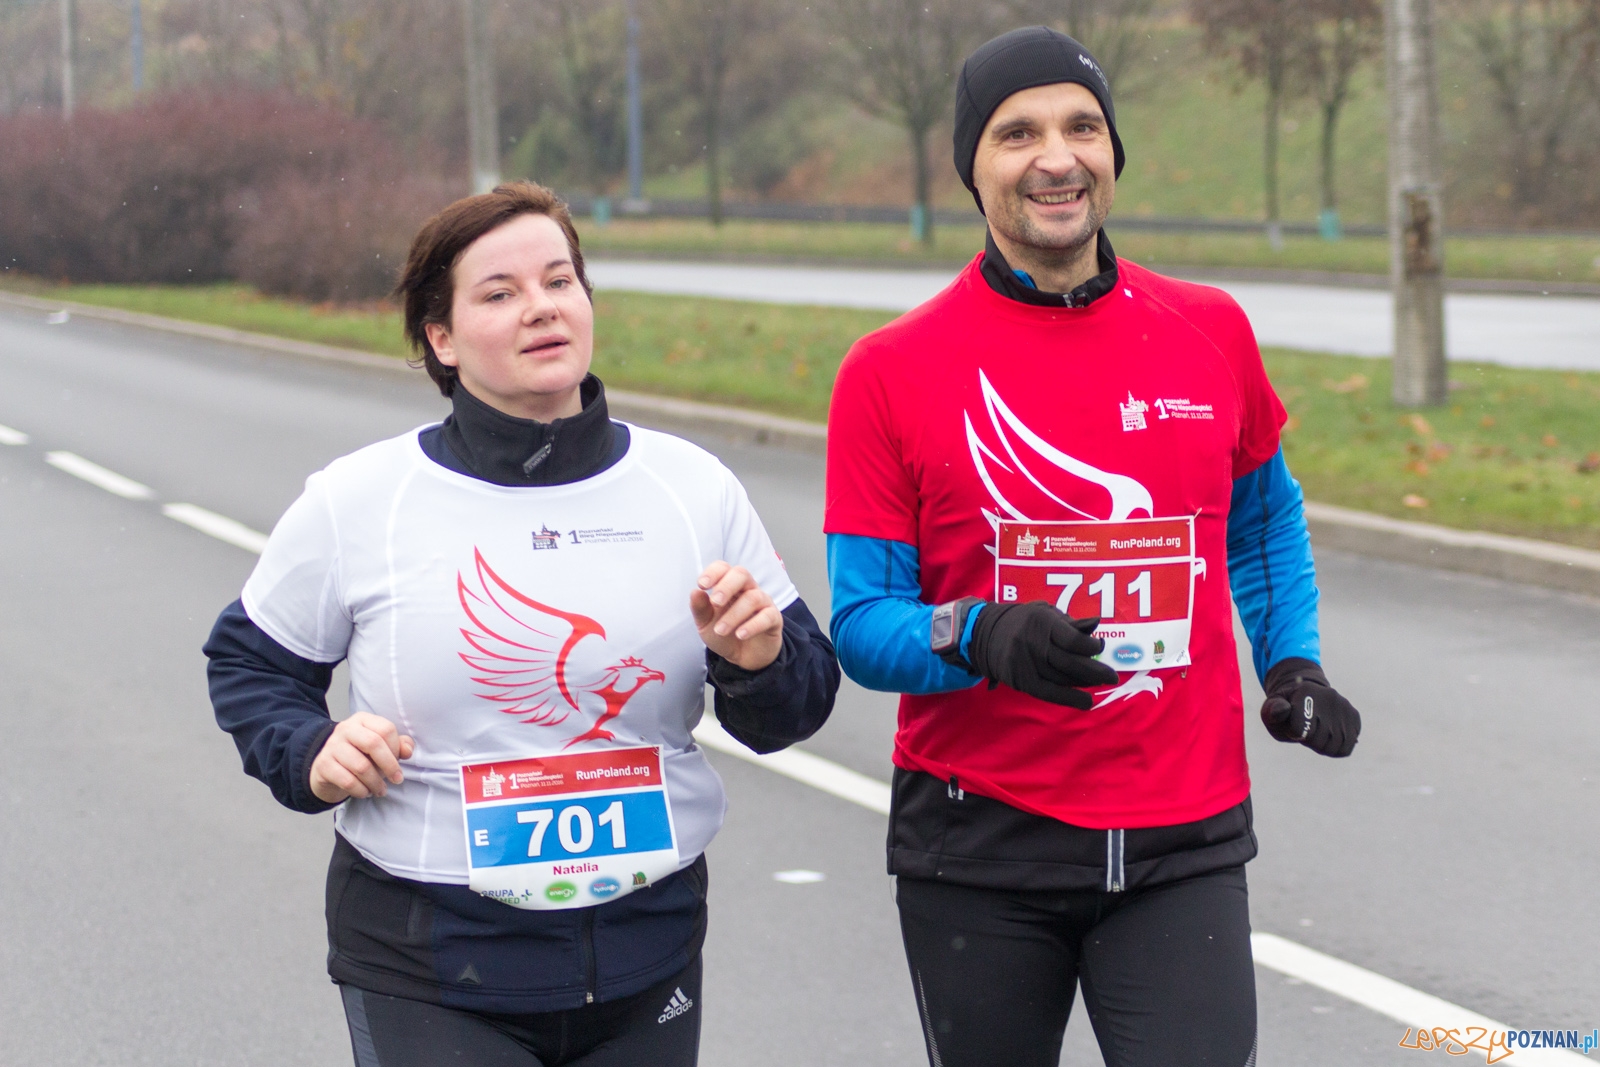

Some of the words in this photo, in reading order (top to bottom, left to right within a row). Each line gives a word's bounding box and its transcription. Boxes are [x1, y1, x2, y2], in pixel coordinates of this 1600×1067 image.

[1154, 398, 1170, 420] 1
[568, 530, 582, 544] 1
[1043, 536, 1052, 552] 1
[1110, 536, 1181, 550] RunPoland.org
[1003, 584, 1018, 601] B
[1046, 570, 1151, 618] 711
[1091, 630, 1126, 638] ymon
[508, 772, 520, 790] 1
[576, 766, 650, 780] RunPoland.org
[474, 829, 490, 846] E
[516, 800, 626, 858] 701
[552, 863, 599, 876] Natalia
[658, 999, 693, 1024] adidas
